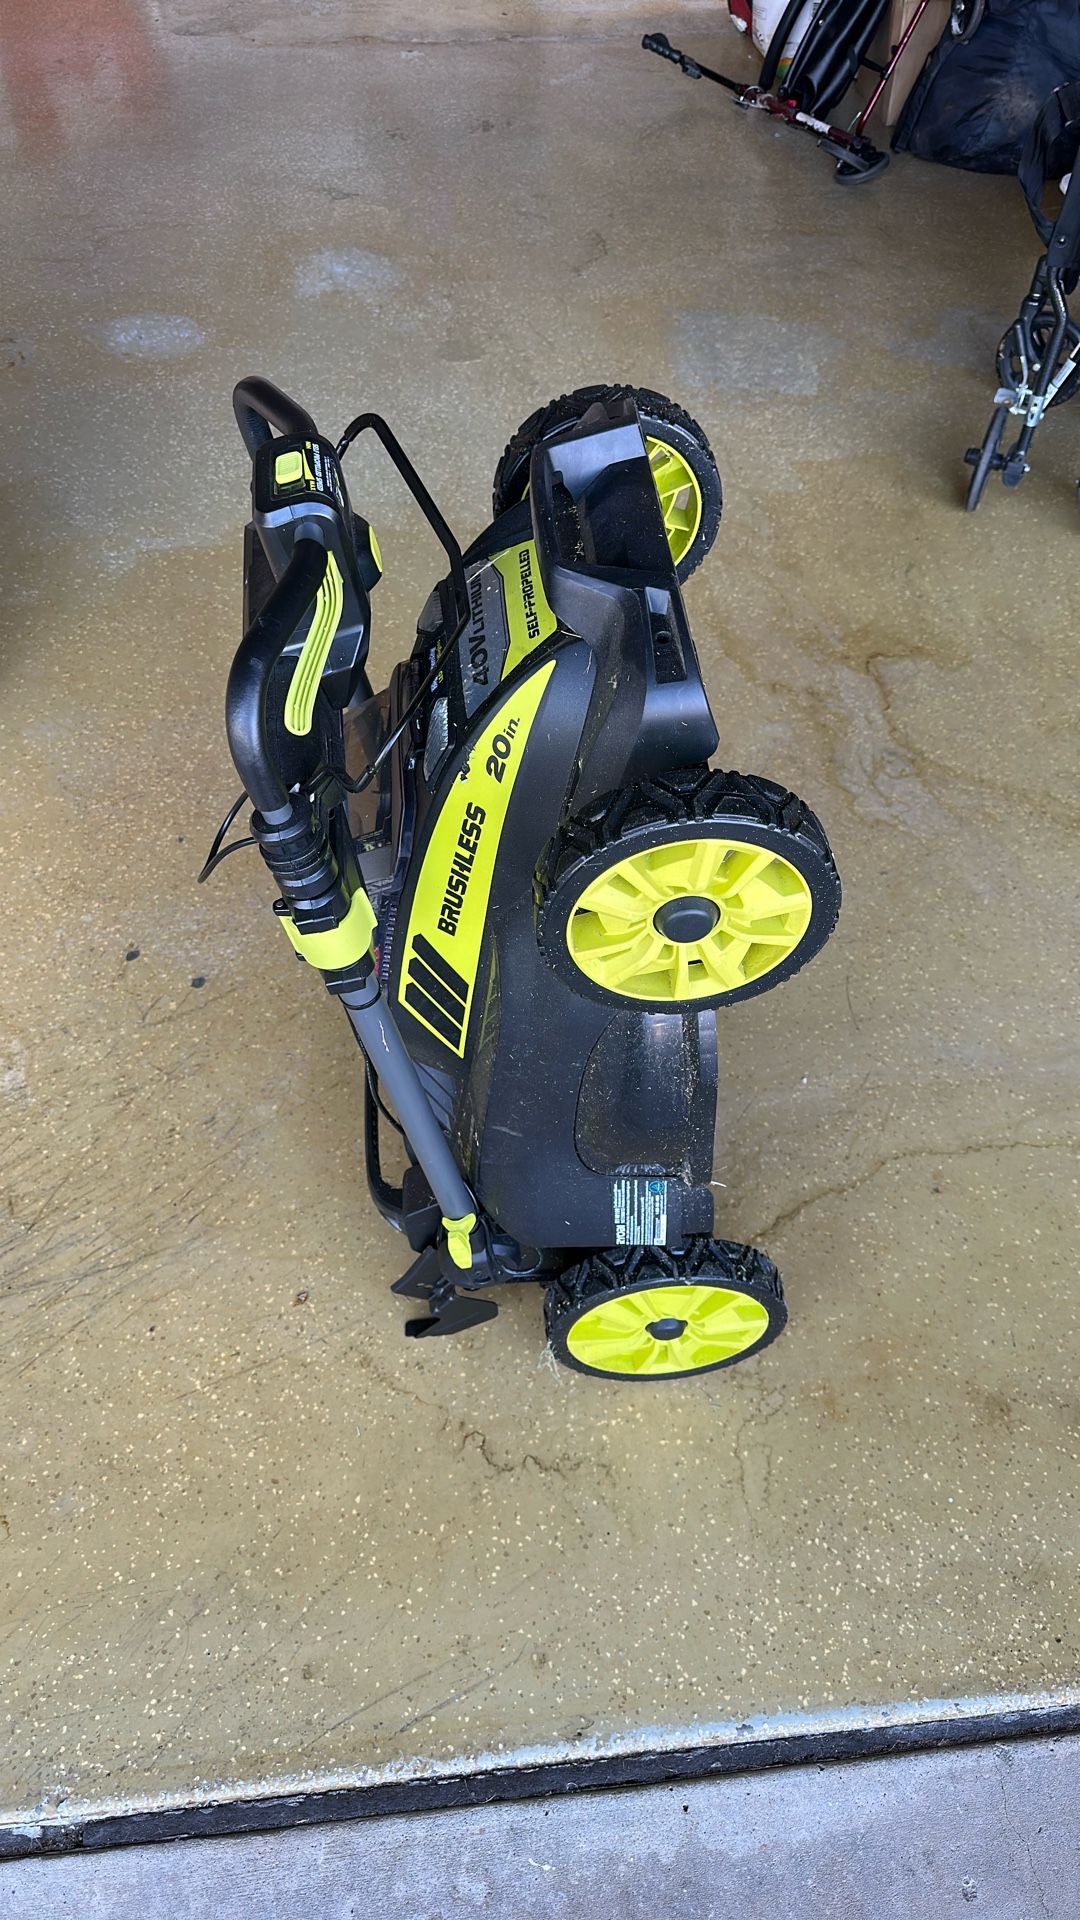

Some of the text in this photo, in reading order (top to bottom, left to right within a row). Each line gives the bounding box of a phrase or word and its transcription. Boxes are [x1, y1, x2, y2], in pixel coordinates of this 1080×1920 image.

[315, 477, 324, 492] SPEED
[519, 548, 540, 640] SELF-PROPELLED
[437, 801, 487, 937] BRUSHLESS
[615, 1224, 626, 1245] RYOBI
